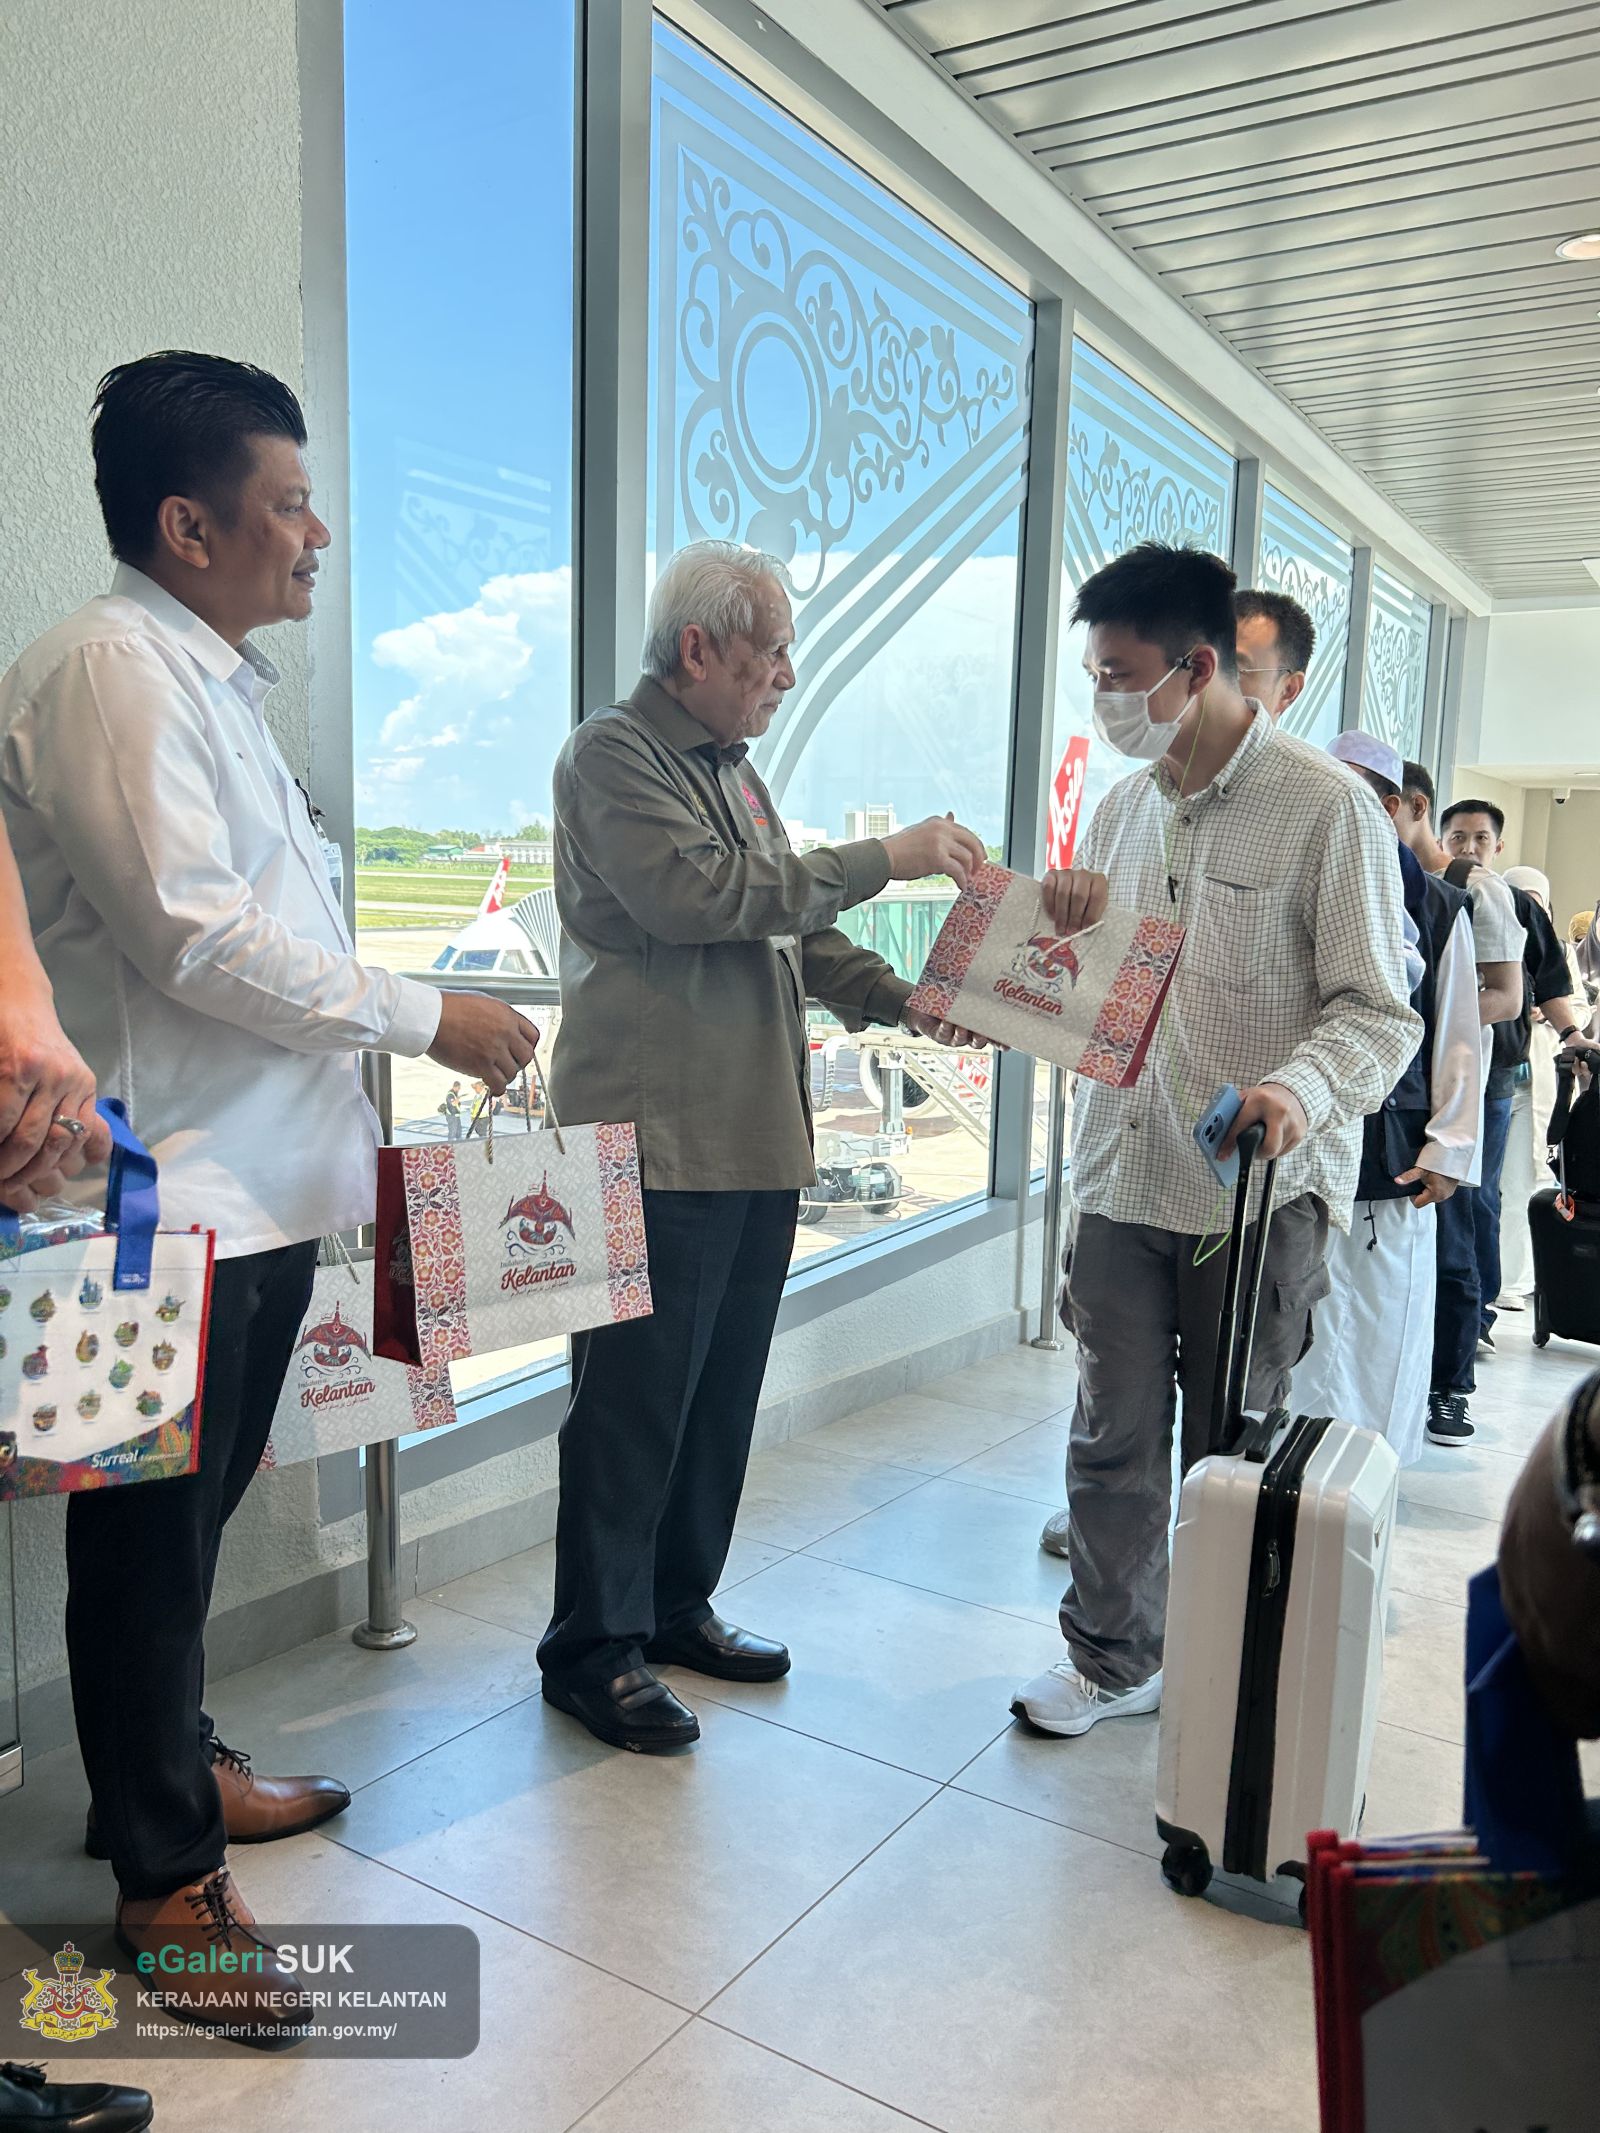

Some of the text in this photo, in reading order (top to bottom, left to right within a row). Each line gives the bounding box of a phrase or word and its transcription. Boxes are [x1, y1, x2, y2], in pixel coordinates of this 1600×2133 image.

[993, 978, 1063, 1016] Kelantan
[501, 1261, 577, 1291] Kelantan
[300, 1380, 376, 1408] Kelantan
[91, 1449, 139, 1468] Surreal
